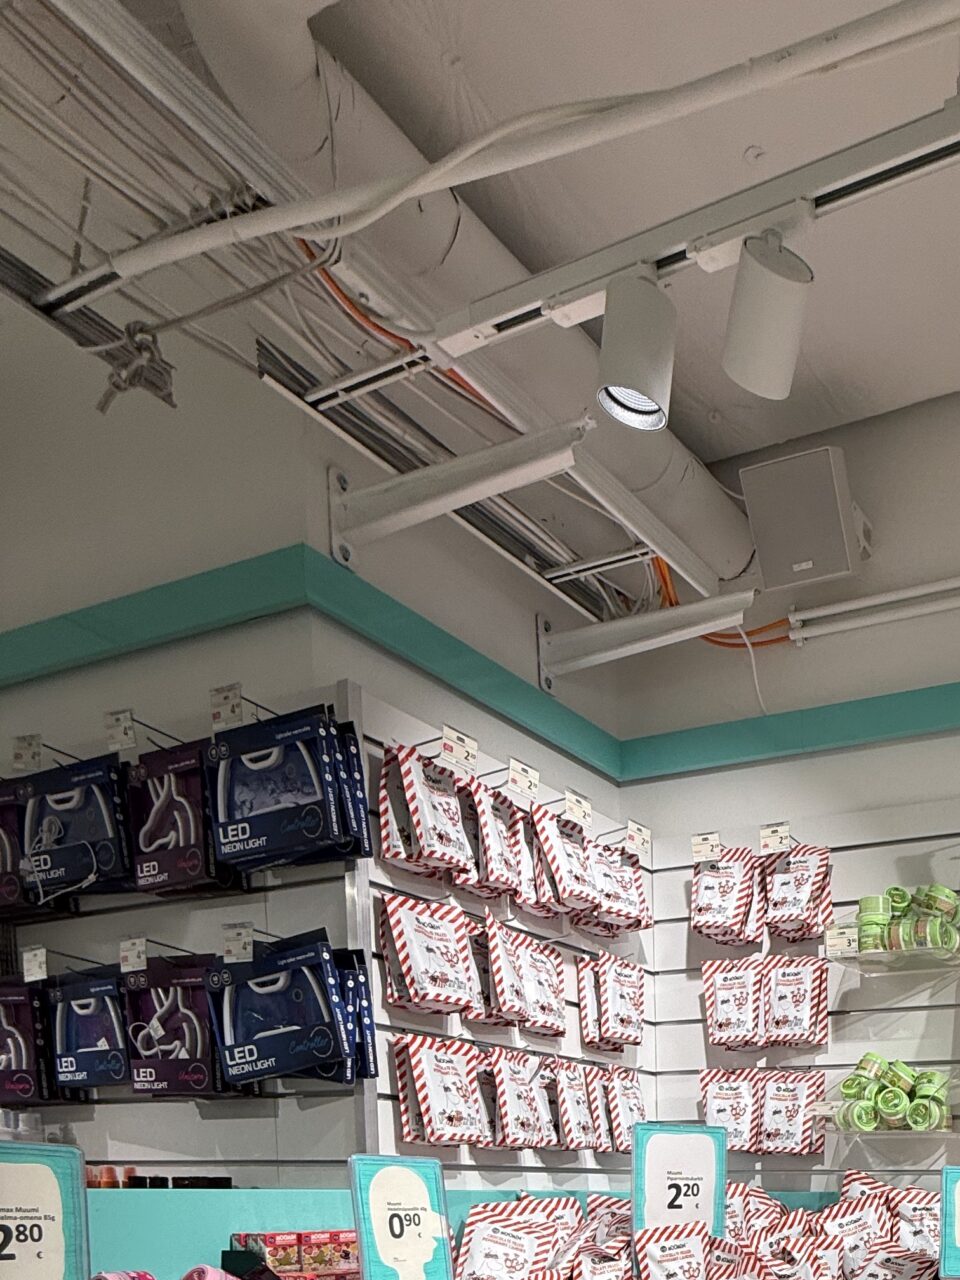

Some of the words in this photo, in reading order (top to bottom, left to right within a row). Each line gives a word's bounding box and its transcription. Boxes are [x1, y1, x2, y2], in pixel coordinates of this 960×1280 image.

[219, 822, 250, 843] LED
[221, 843, 244, 854] NEON
[244, 836, 267, 850] LIGHT
[137, 861, 158, 876] LED
[155, 873, 169, 883] LIGHT
[225, 1045, 258, 1065] LED
[57, 1057, 76, 1072] LED
[228, 1063, 252, 1076] NEON
[253, 1058, 276, 1071] LIGHT
[58, 1073, 73, 1082] NEON
[72, 1071, 87, 1080] LIGHT
[133, 1068, 155, 1082] LED
[134, 1082, 150, 1090] NEON
[150, 1081, 168, 1089] LIGHT
